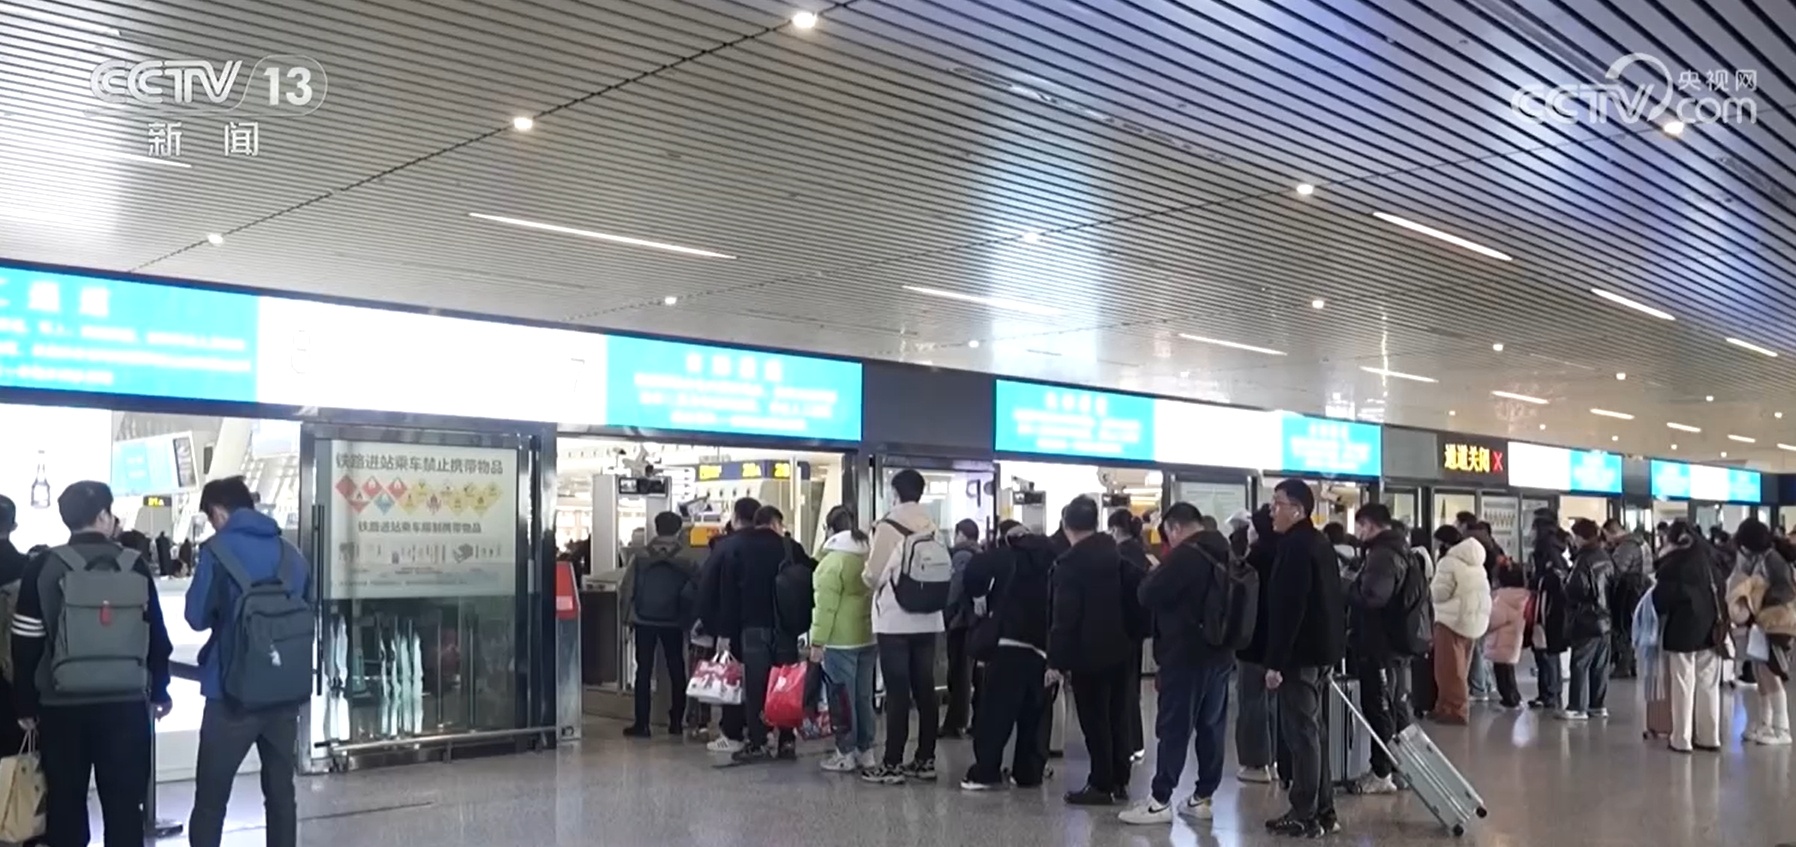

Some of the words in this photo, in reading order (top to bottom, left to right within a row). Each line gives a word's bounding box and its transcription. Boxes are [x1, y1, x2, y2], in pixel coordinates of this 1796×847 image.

[336, 452, 504, 475] 铁路进站乘车禁止携带物品
